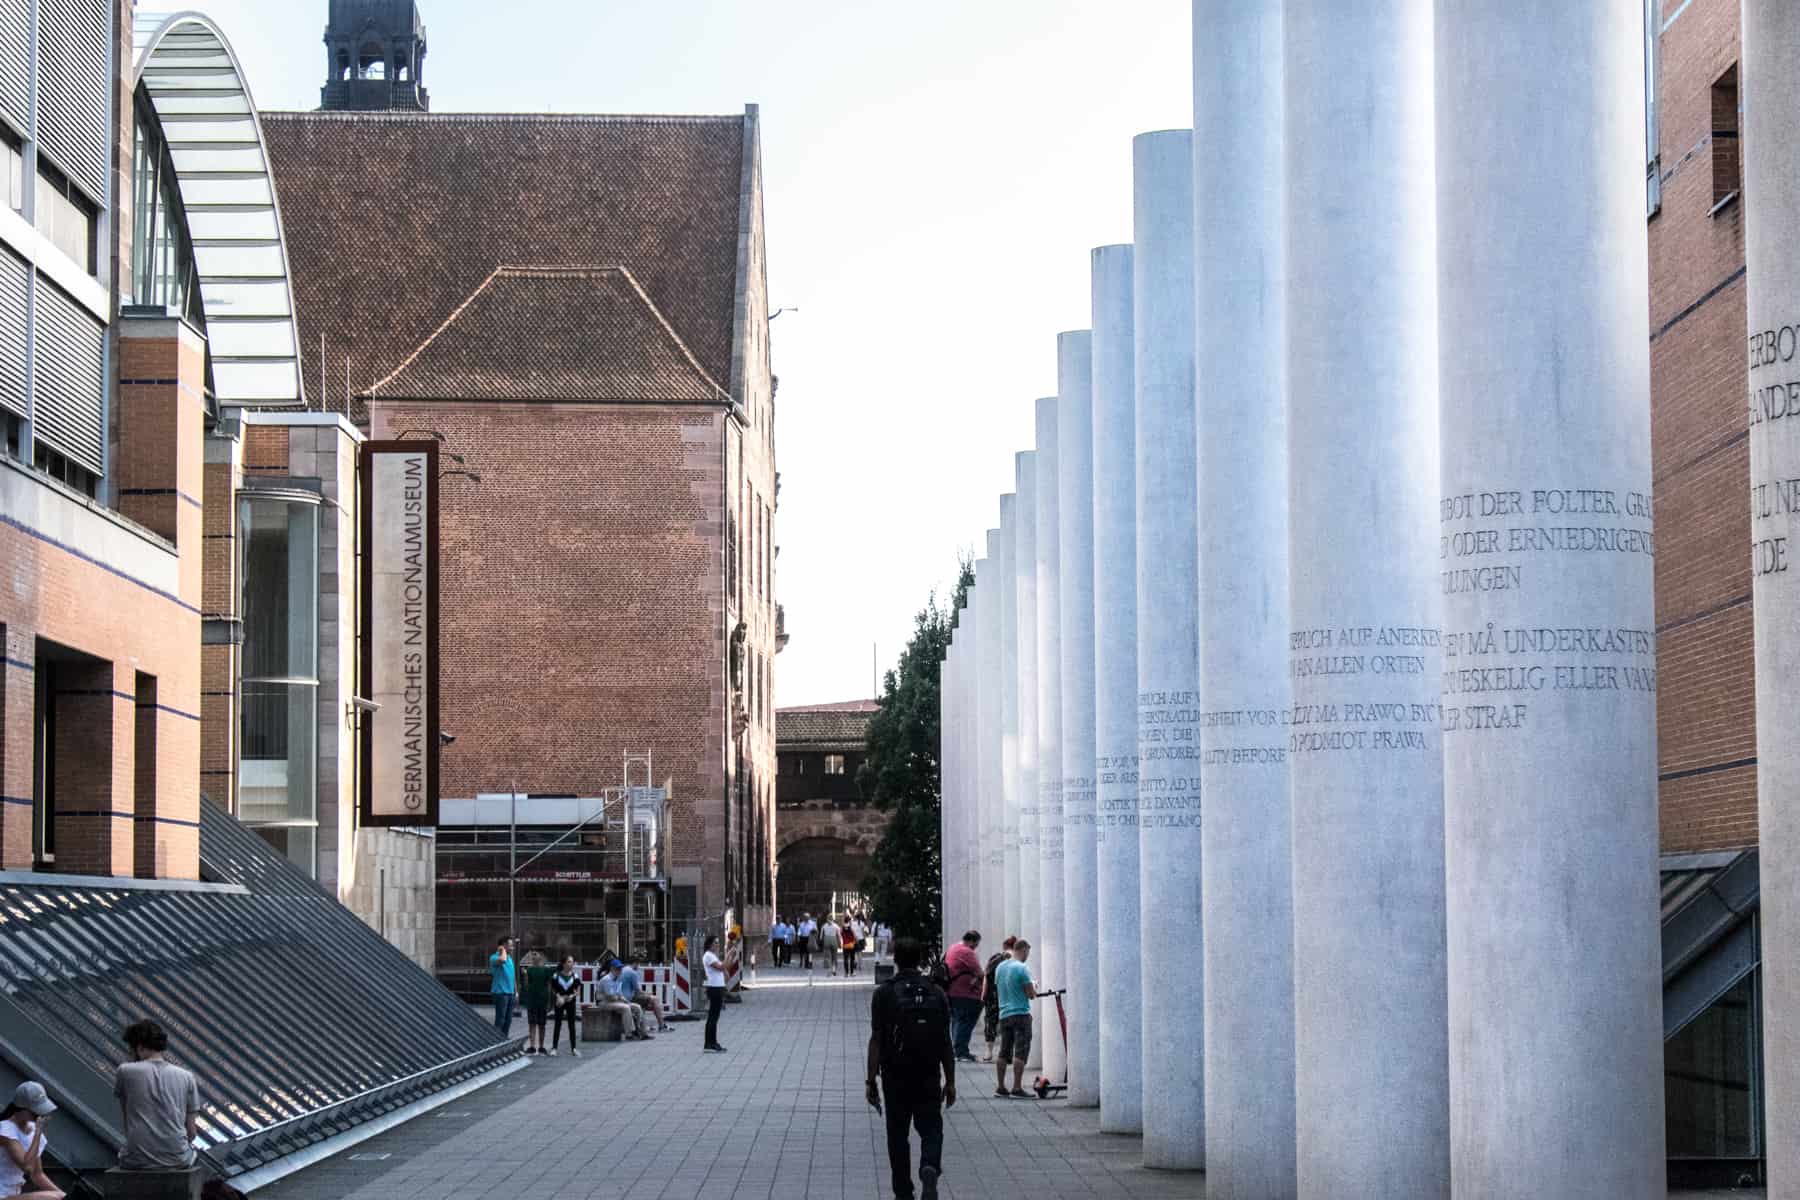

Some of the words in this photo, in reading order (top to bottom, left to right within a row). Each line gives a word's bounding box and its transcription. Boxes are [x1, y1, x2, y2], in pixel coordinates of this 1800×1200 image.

[1480, 491, 1524, 517] DER
[1532, 489, 1622, 516] FOLTER,
[404, 457, 423, 646] NATIONALMUSEUM
[1452, 530, 1501, 557] ODER
[1336, 627, 1372, 647] AUF
[1468, 622, 1497, 655] MÅ
[1503, 628, 1649, 655] UNDERKASTES
[1315, 655, 1365, 675] ALLEN
[1370, 655, 1425, 674] ORTEN
[1552, 665, 1619, 690] ELLER
[1247, 711, 1277, 725] VOR
[1343, 703, 1406, 722] PRAWO
[1464, 704, 1528, 730] STRAF
[404, 653, 423, 811] GERMANISCHES
[1372, 730, 1428, 750] PRAWA
[1232, 748, 1287, 765] BEFORE
